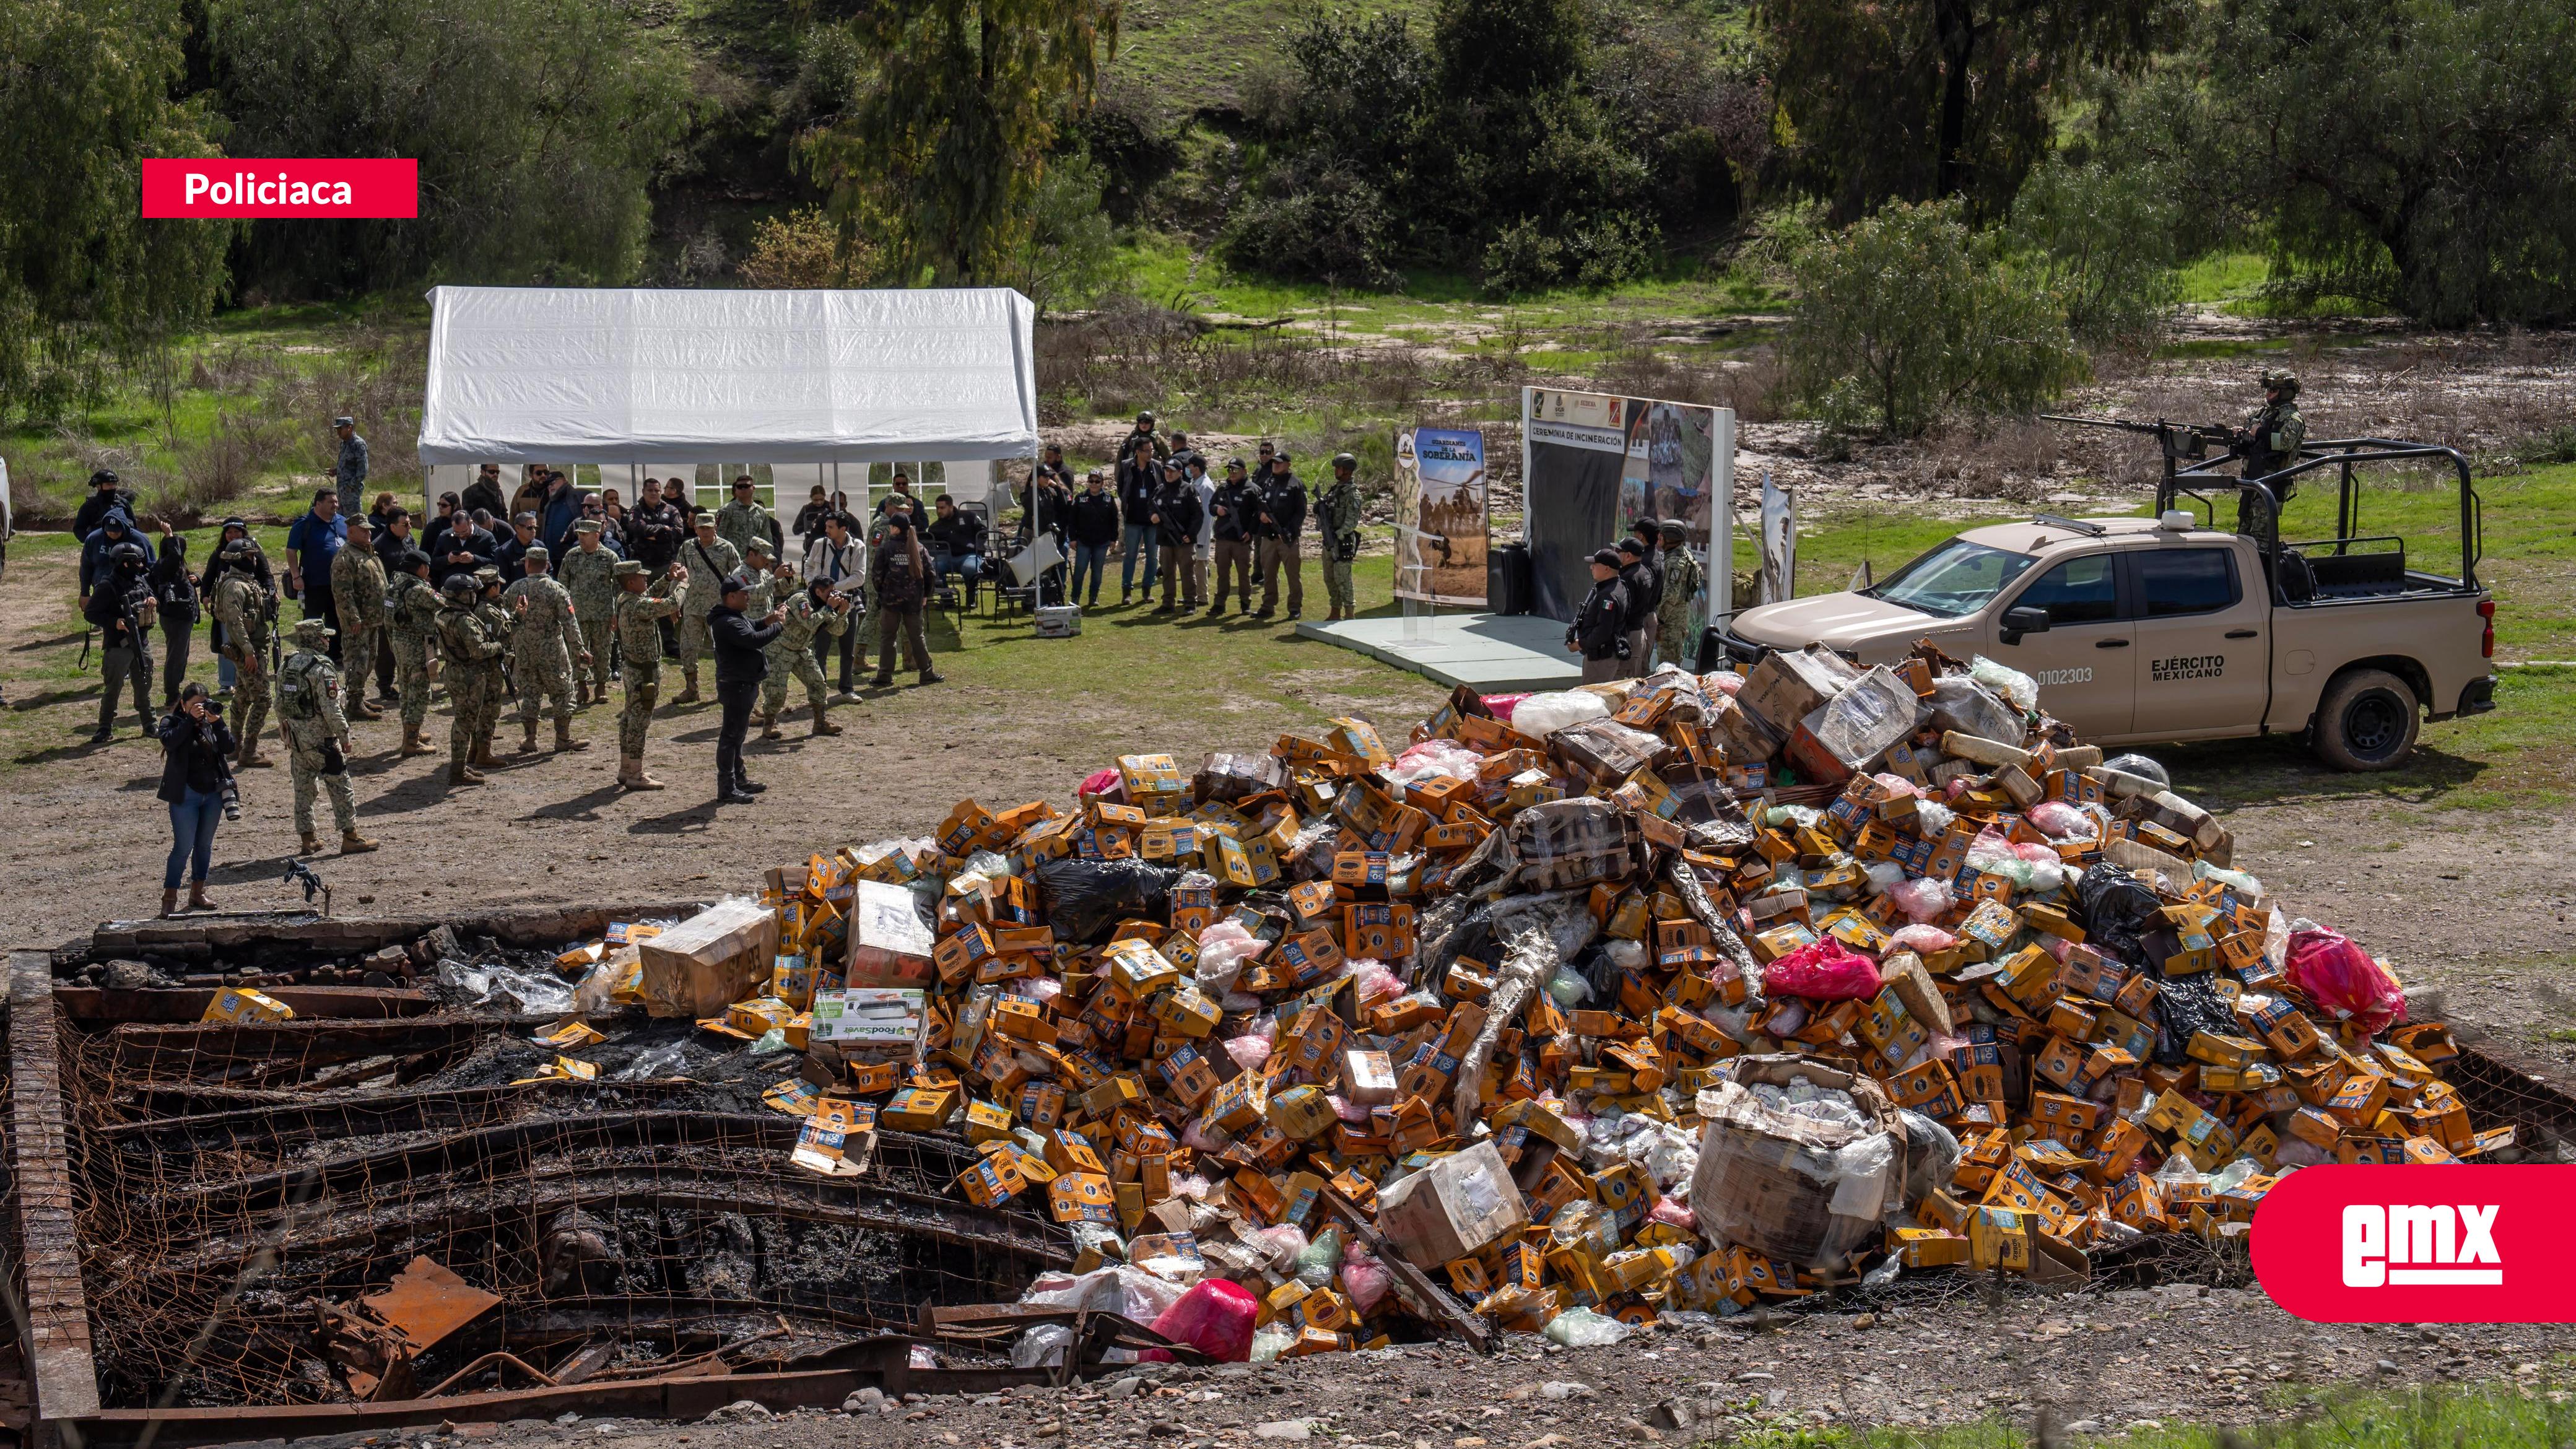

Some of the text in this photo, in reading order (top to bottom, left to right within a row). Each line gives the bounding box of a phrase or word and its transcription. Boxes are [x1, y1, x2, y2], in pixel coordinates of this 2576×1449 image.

[1533, 427, 1622, 446] CEREMONIA DE INCINERACIÓN
[1423, 450, 1476, 461] SOBERANÍA
[2151, 655, 2224, 672] EJÉRCITO
[2037, 667, 2093, 686] 0102303
[2152, 668, 2222, 682] MEXICANO
[1949, 842, 1964, 851] 150g
[1962, 866, 1976, 875] 50%
[1372, 872, 1383, 881] 50%
[1310, 937, 1328, 949] SOBRE!
[1286, 947, 1299, 957] 50%
[843, 1026, 896, 1035] FoodSaver
[2291, 1021, 2308, 1040] SOBRE!
[1984, 1046, 1993, 1063] 50%
[1194, 1069, 1207, 1085] SOBRE!
[2044, 1102, 2061, 1110] 150g
[999, 1160, 1011, 1170] SOBRE!
[981, 1166, 991, 1177] 50%
[1312, 1296, 1331, 1311] SOBRE!
